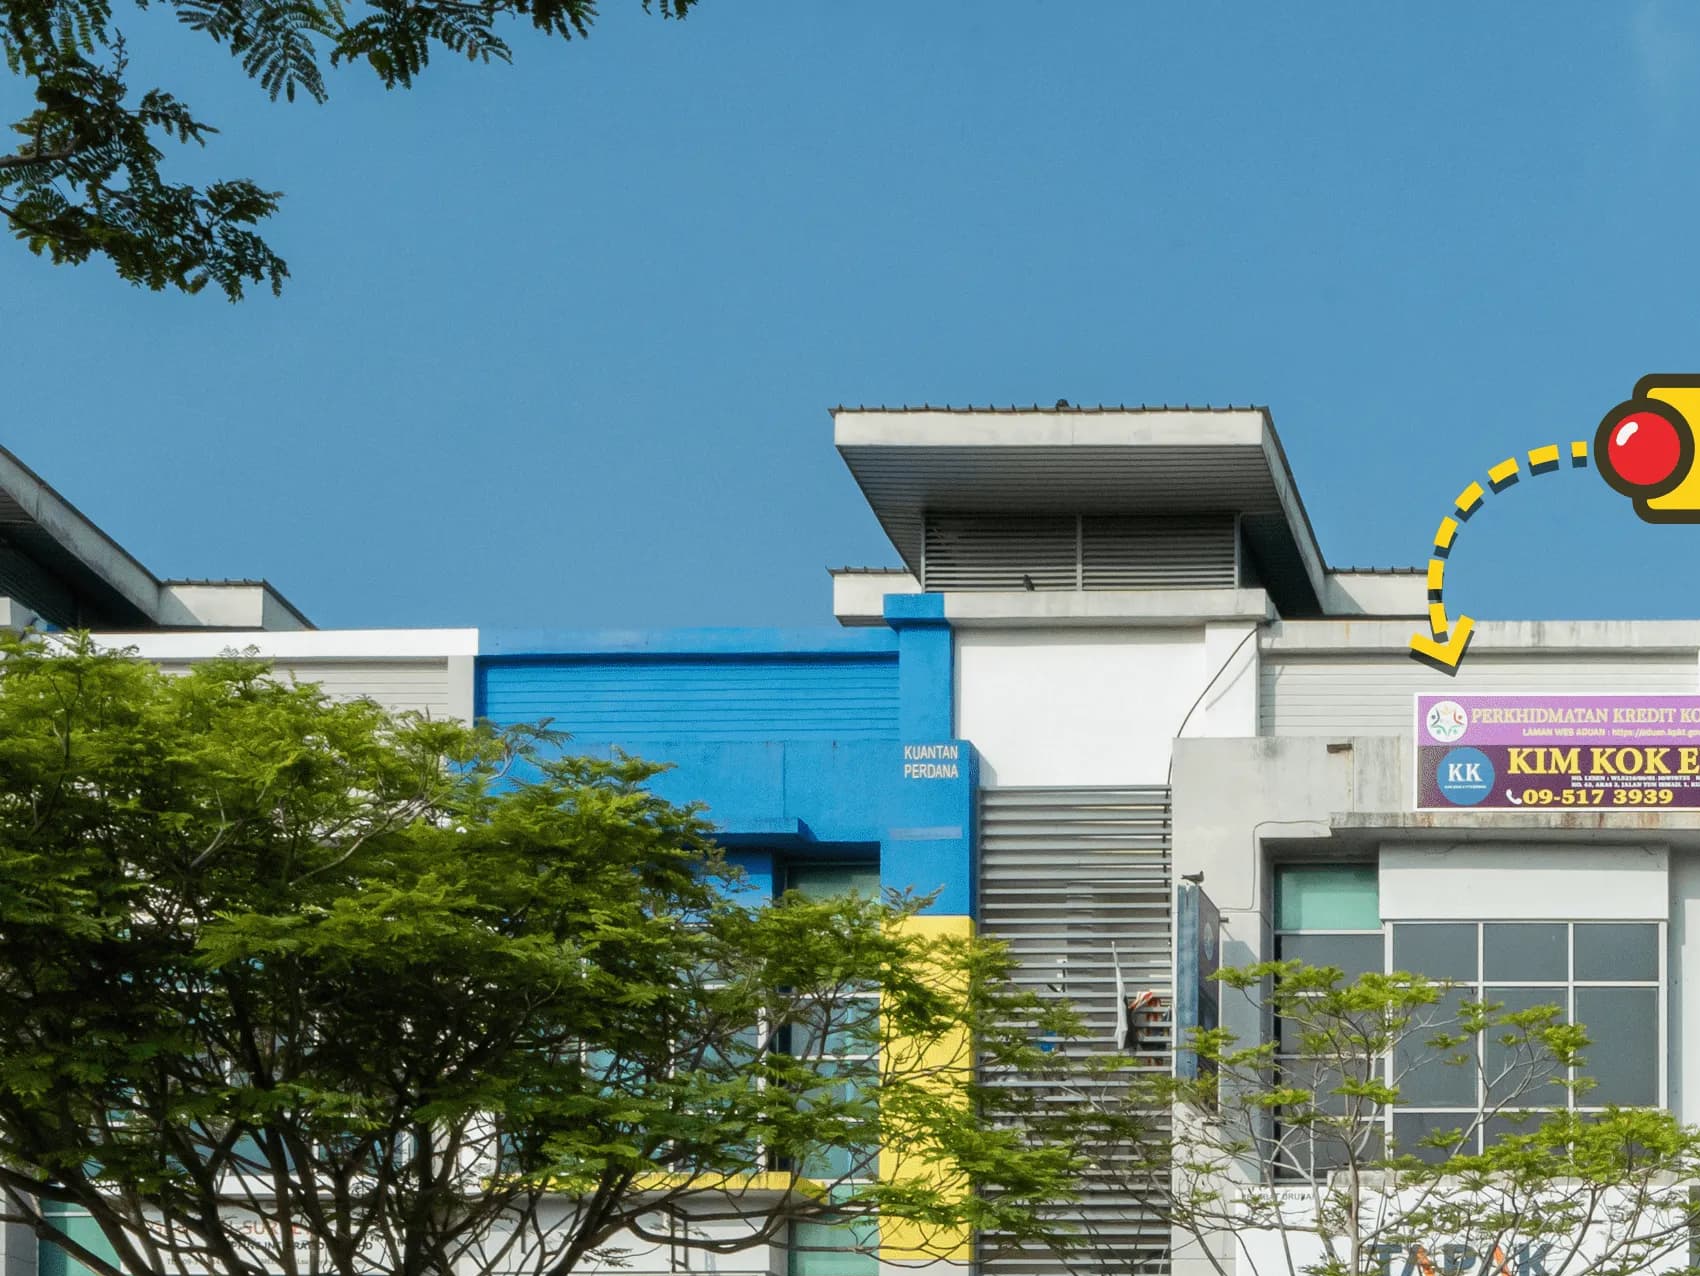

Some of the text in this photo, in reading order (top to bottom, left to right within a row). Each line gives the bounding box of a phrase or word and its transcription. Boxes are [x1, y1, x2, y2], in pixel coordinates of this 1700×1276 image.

[1471, 708, 1608, 723] PERKHIDMATAN
[1612, 708, 1677, 723] KREDIT
[904, 745, 958, 760] KUANTAN
[1507, 747, 1582, 775] KIM
[1590, 747, 1671, 775] KOK
[904, 764, 959, 779] PERDANA
[1448, 763, 1483, 782] KK
[1522, 789, 1674, 804] 09-517 3939
